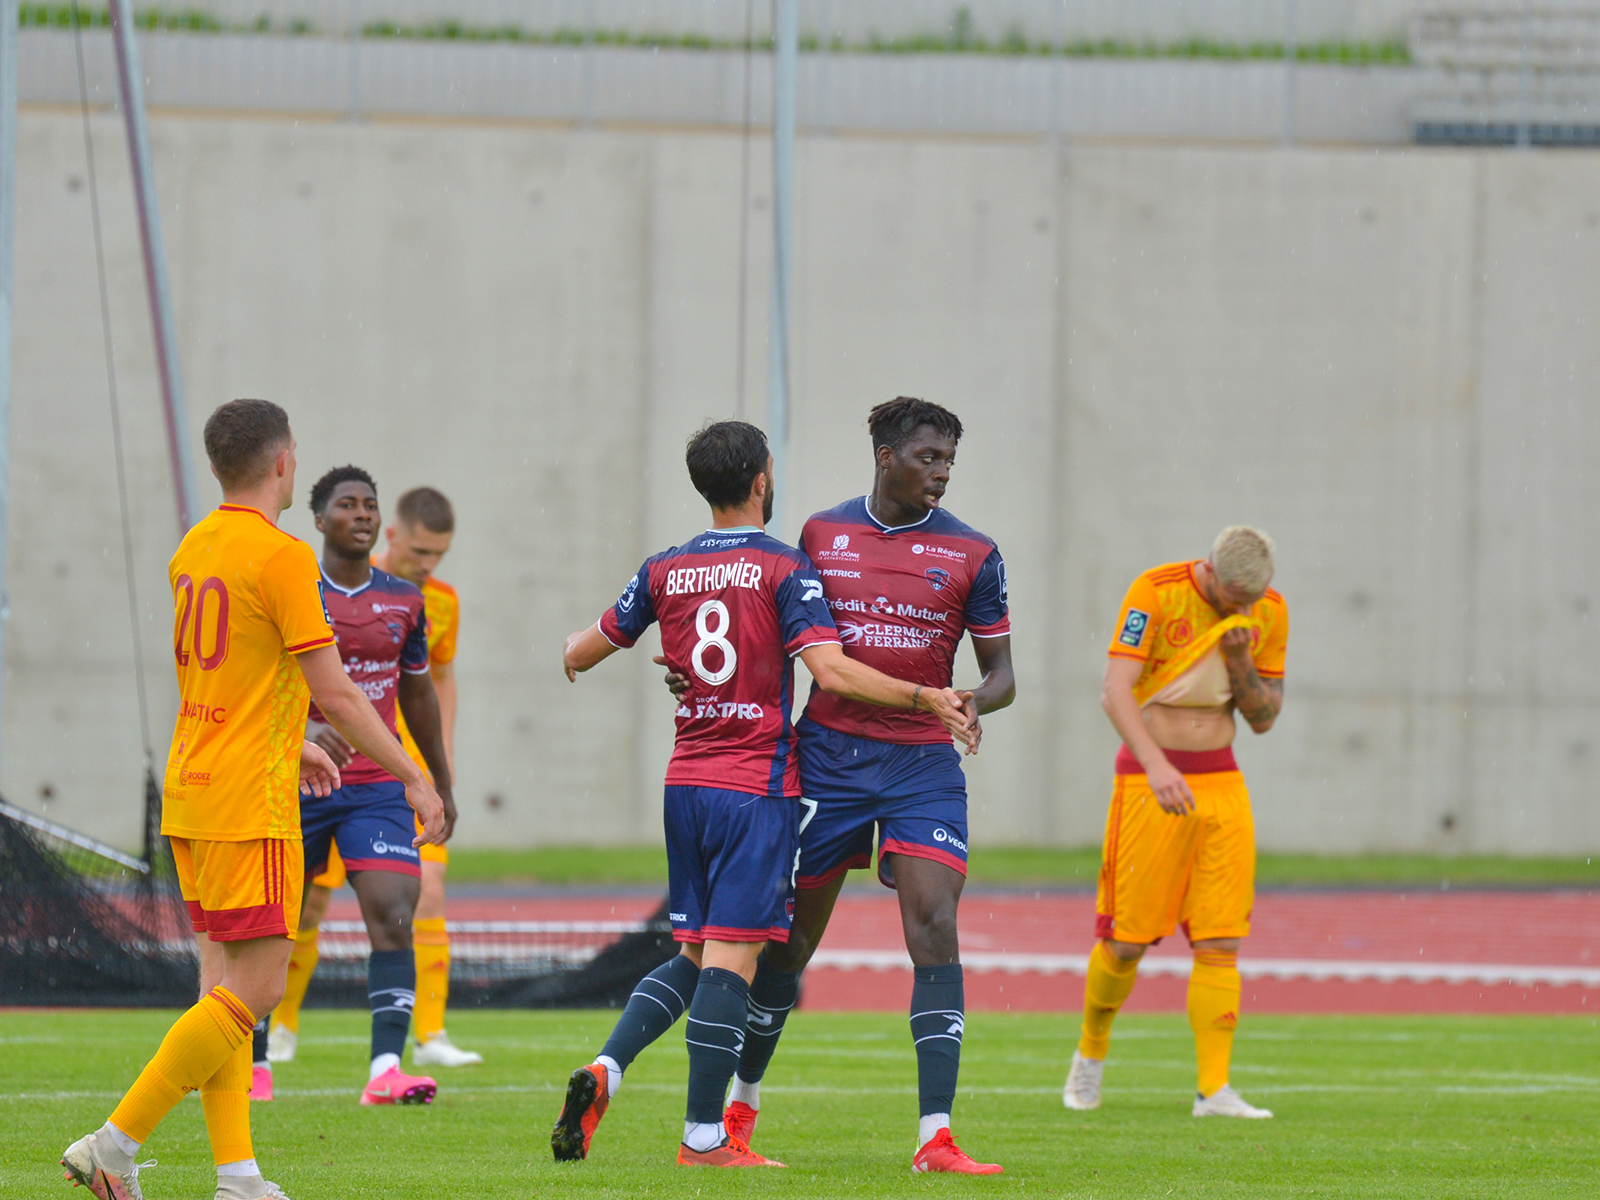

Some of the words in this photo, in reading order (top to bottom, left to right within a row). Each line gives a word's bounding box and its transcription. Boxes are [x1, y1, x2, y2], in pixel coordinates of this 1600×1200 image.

[937, 547, 966, 558] Région
[822, 569, 861, 578] PATRICK
[897, 603, 948, 621] Mutuel
[175, 573, 230, 671] 20
[863, 623, 943, 638] CLERMONT
[692, 599, 737, 686] 8
[865, 635, 931, 648] FERRAND
[188, 772, 210, 781] RODEZ
[948, 835, 968, 853] VEOL
[669, 912, 687, 922] TRICK
